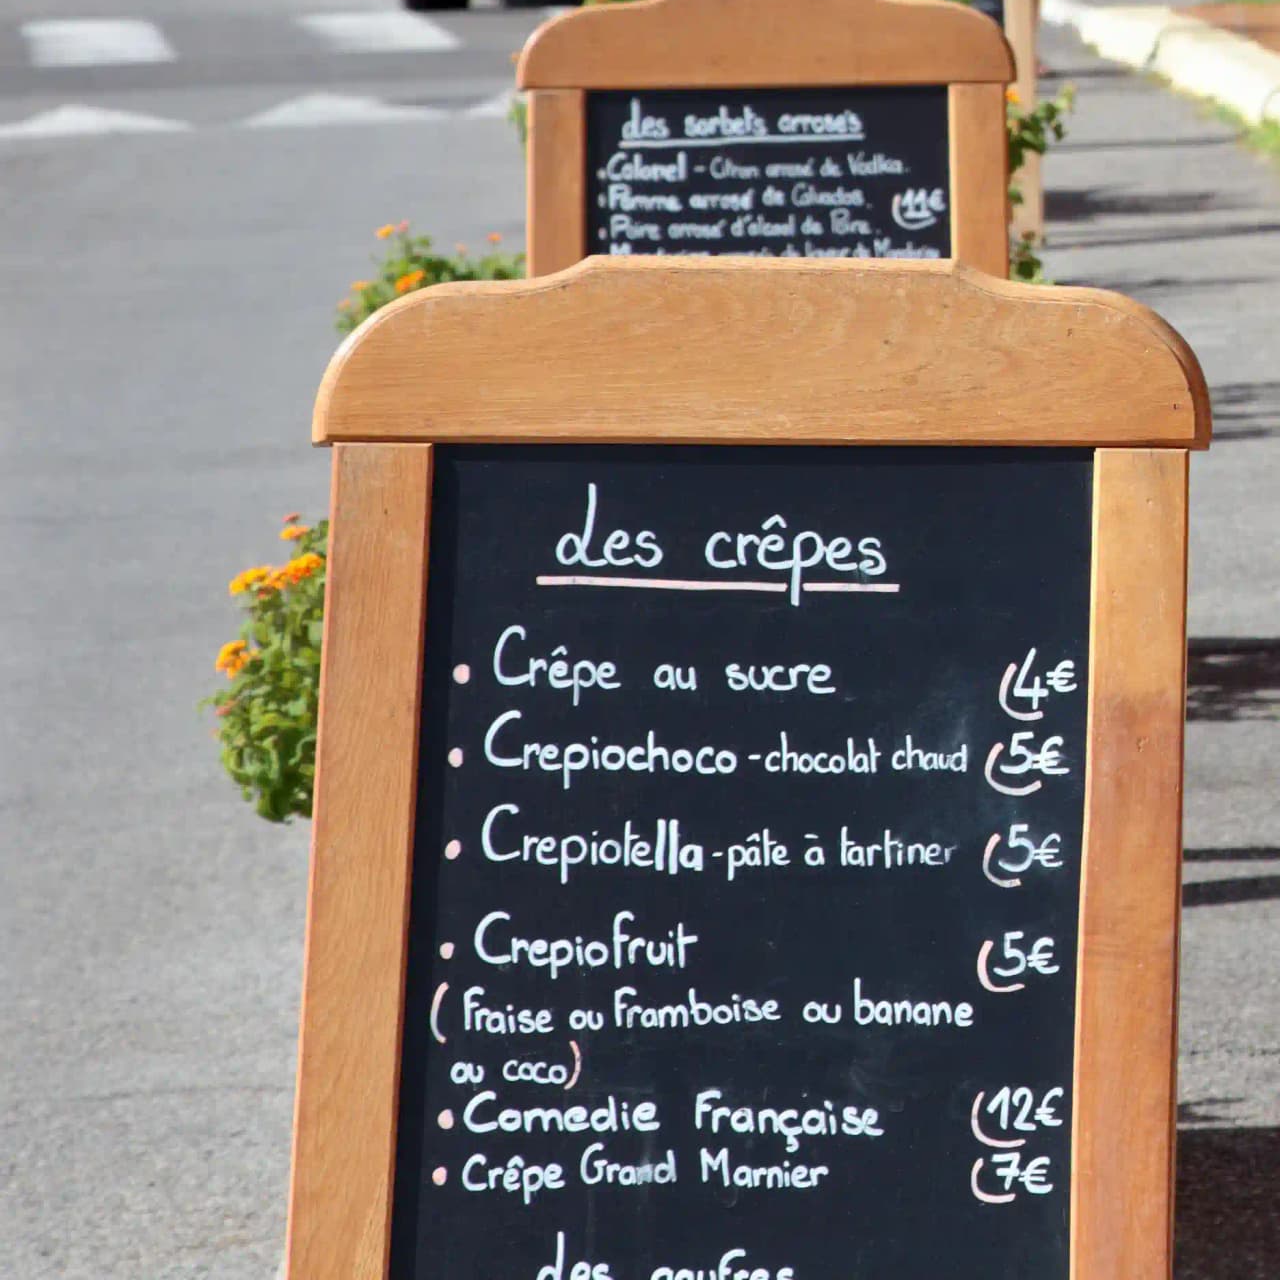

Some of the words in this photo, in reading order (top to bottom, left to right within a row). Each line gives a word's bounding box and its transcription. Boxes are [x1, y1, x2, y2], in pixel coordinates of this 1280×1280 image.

[684, 105, 769, 138] sorbets
[606, 151, 688, 183] Colonel
[607, 182, 683, 212] Pomme
[762, 185, 786, 207] de
[610, 213, 661, 241] Poire
[704, 514, 887, 607] crêpes
[493, 624, 621, 707] Crêpe
[653, 664, 697, 691] au
[725, 663, 836, 694] sucre
[484, 710, 738, 790] Crepiochoco
[891, 734, 968, 773] chaud
[481, 803, 703, 885] Crepiotella
[840, 826, 957, 869] tartiner
[474, 910, 699, 980] Crepiofruit
[569, 1009, 604, 1031] ou
[802, 1001, 842, 1024] ou
[853, 977, 974, 1027] banane
[450, 1061, 485, 1085] ou
[463, 1090, 661, 1134] Comedie
[694, 1090, 884, 1153] Française
[462, 1153, 566, 1205] Crêpe
[580, 1142, 678, 1185] Grand
[700, 1147, 829, 1189] Marnier
